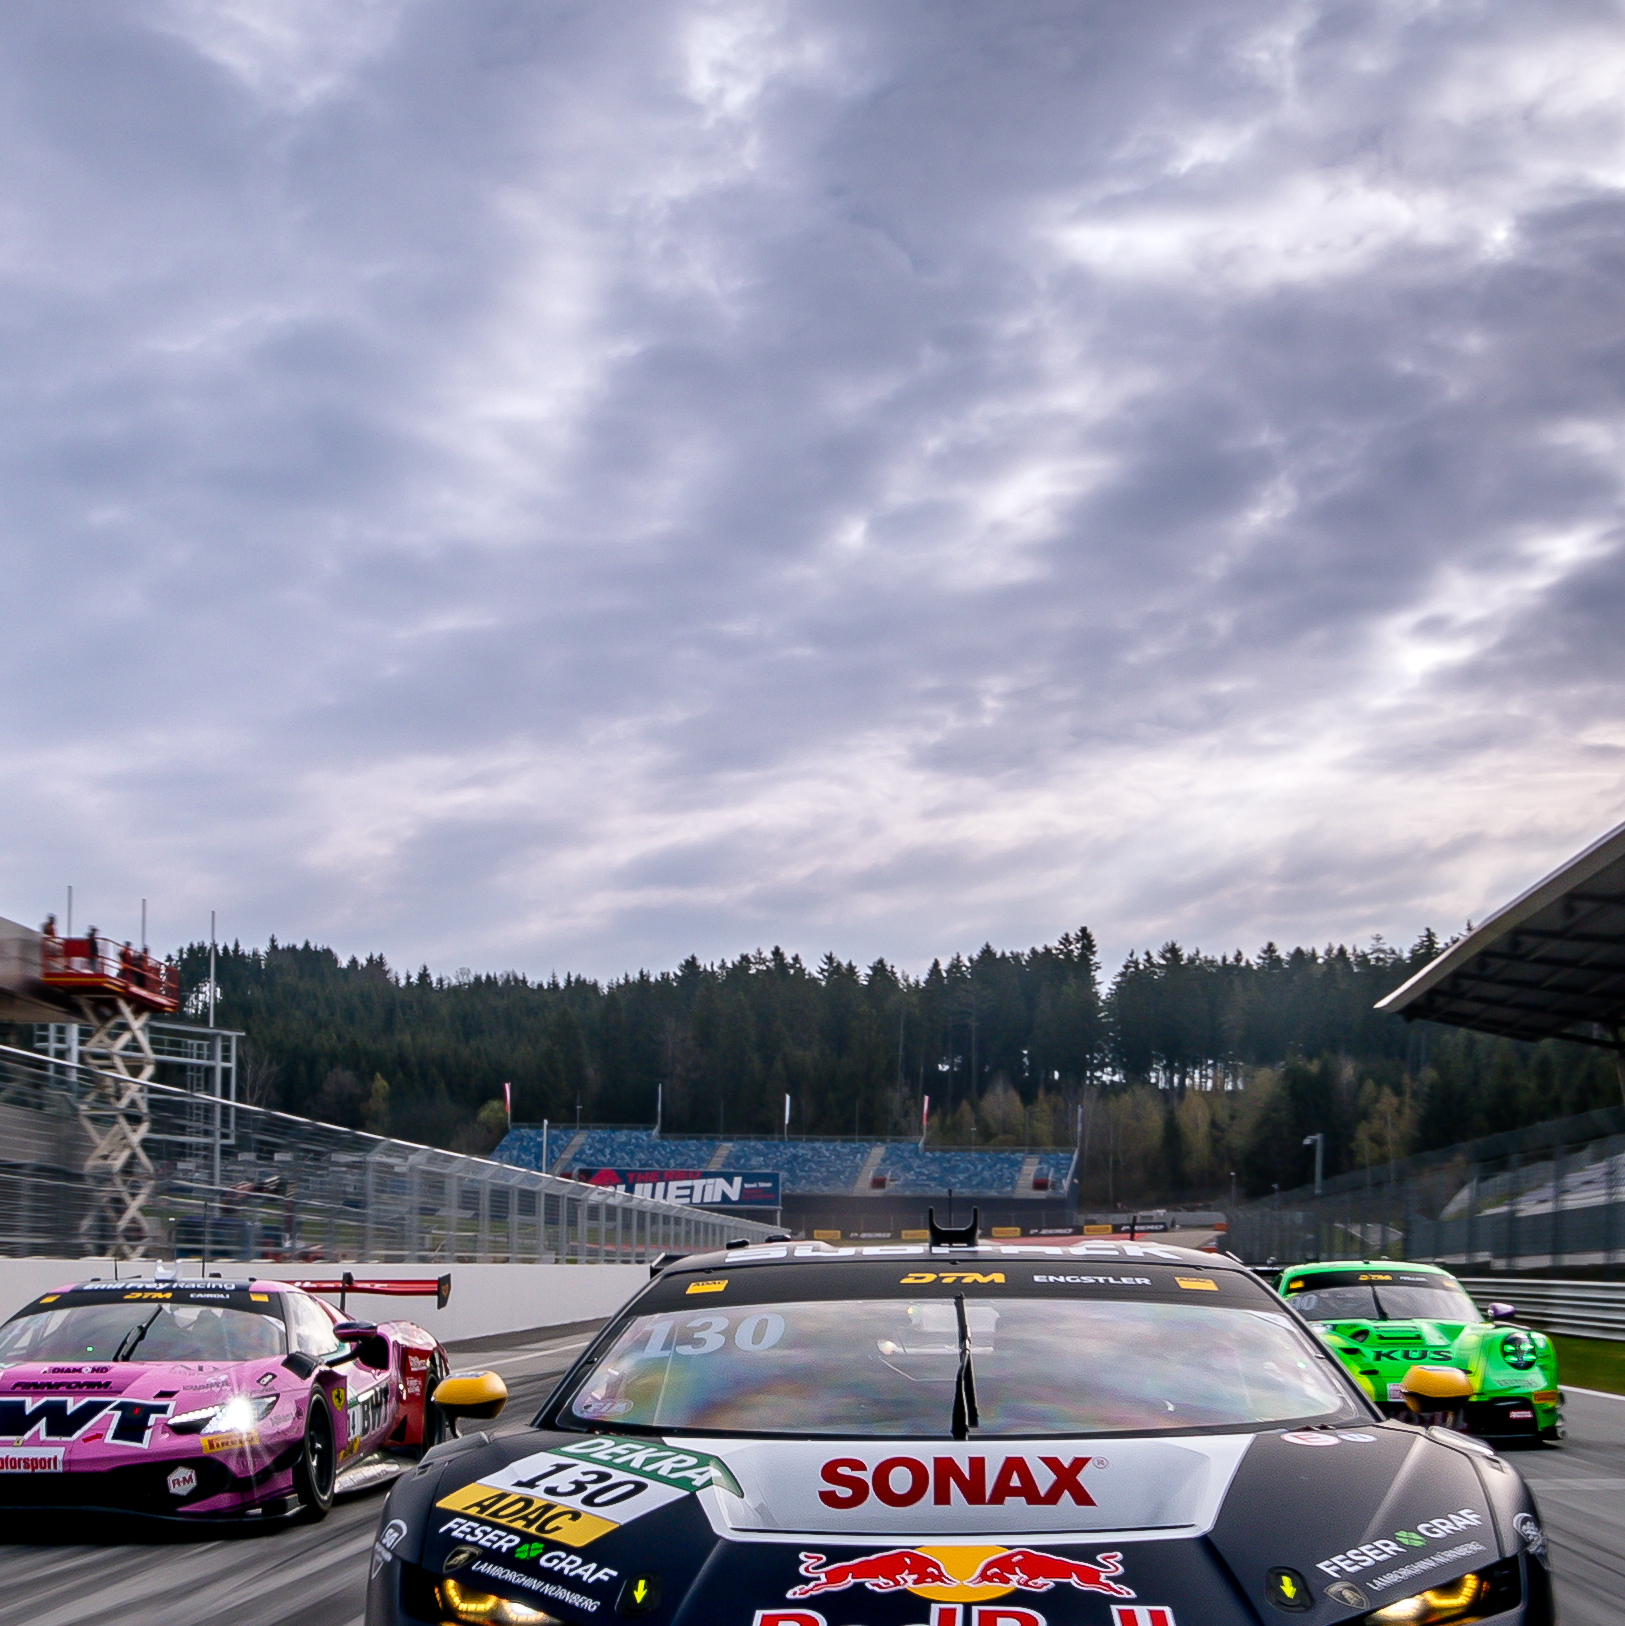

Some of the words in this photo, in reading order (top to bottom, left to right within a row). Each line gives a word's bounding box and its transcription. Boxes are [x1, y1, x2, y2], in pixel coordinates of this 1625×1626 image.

[627, 1171, 661, 1184] THE
[172, 1282, 236, 1291] Racing
[900, 1272, 1005, 1284] DTM
[1033, 1274, 1151, 1286] ENGSTLER
[636, 1313, 786, 1358] 130
[513, 1461, 649, 1508] 130
[560, 1438, 713, 1488] DEKRA
[817, 1455, 1099, 1509] SONAX
[462, 1492, 581, 1537] ADAC
[439, 1517, 521, 1552] FESER
[539, 1550, 619, 1585] GRAF
[1316, 1538, 1407, 1578] FESER
[1416, 1508, 1484, 1539] GRAF
[471, 1560, 545, 1591] LAMBORGHINI
